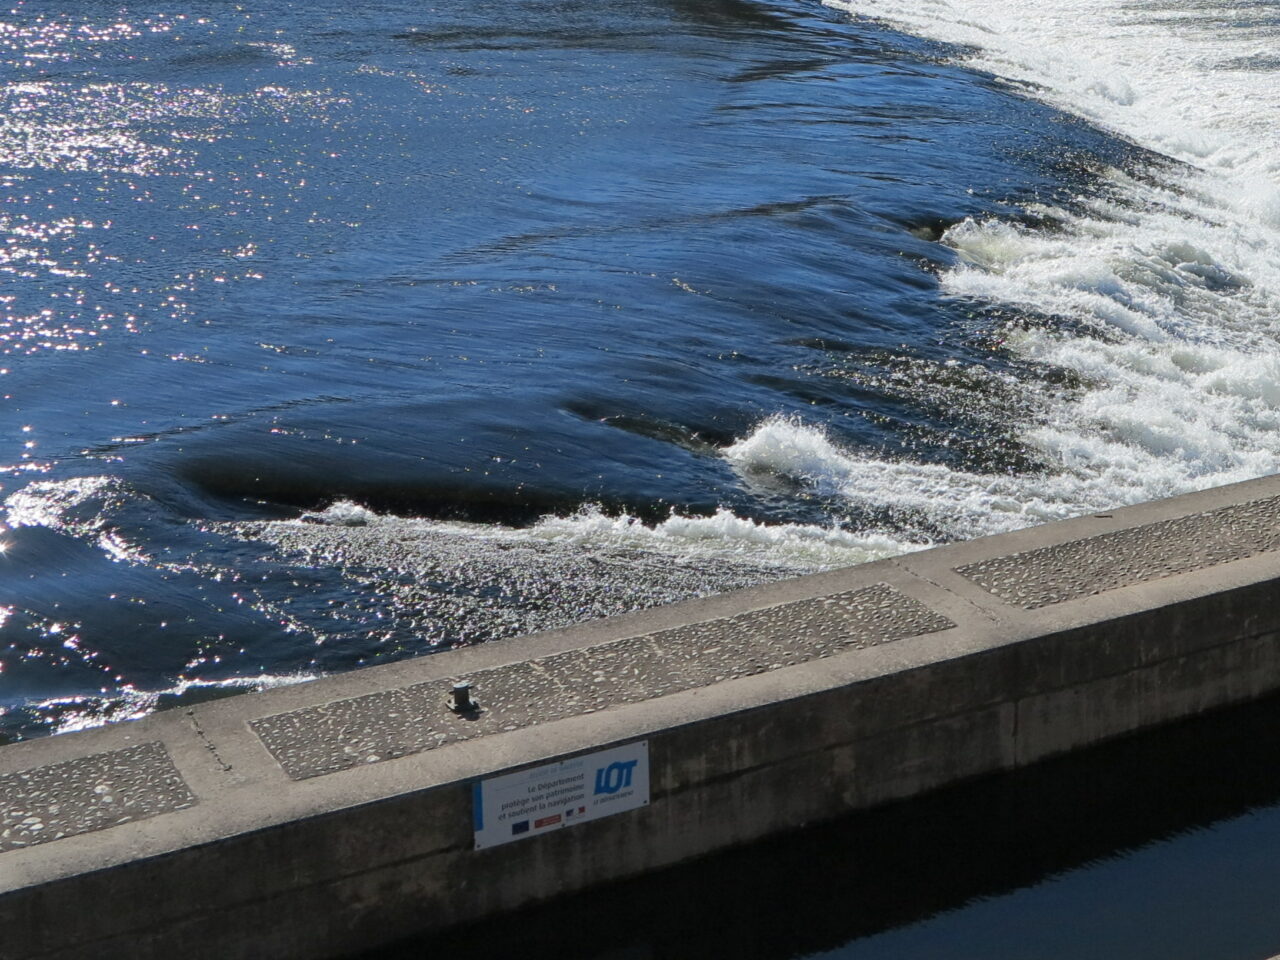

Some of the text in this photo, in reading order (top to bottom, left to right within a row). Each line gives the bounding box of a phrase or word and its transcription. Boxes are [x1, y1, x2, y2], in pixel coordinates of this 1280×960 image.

[538, 773, 584, 791] Département
[593, 759, 638, 796] LOT
[498, 793, 585, 821] et soutient la navigation
[501, 783, 585, 811] protège son patrimoine
